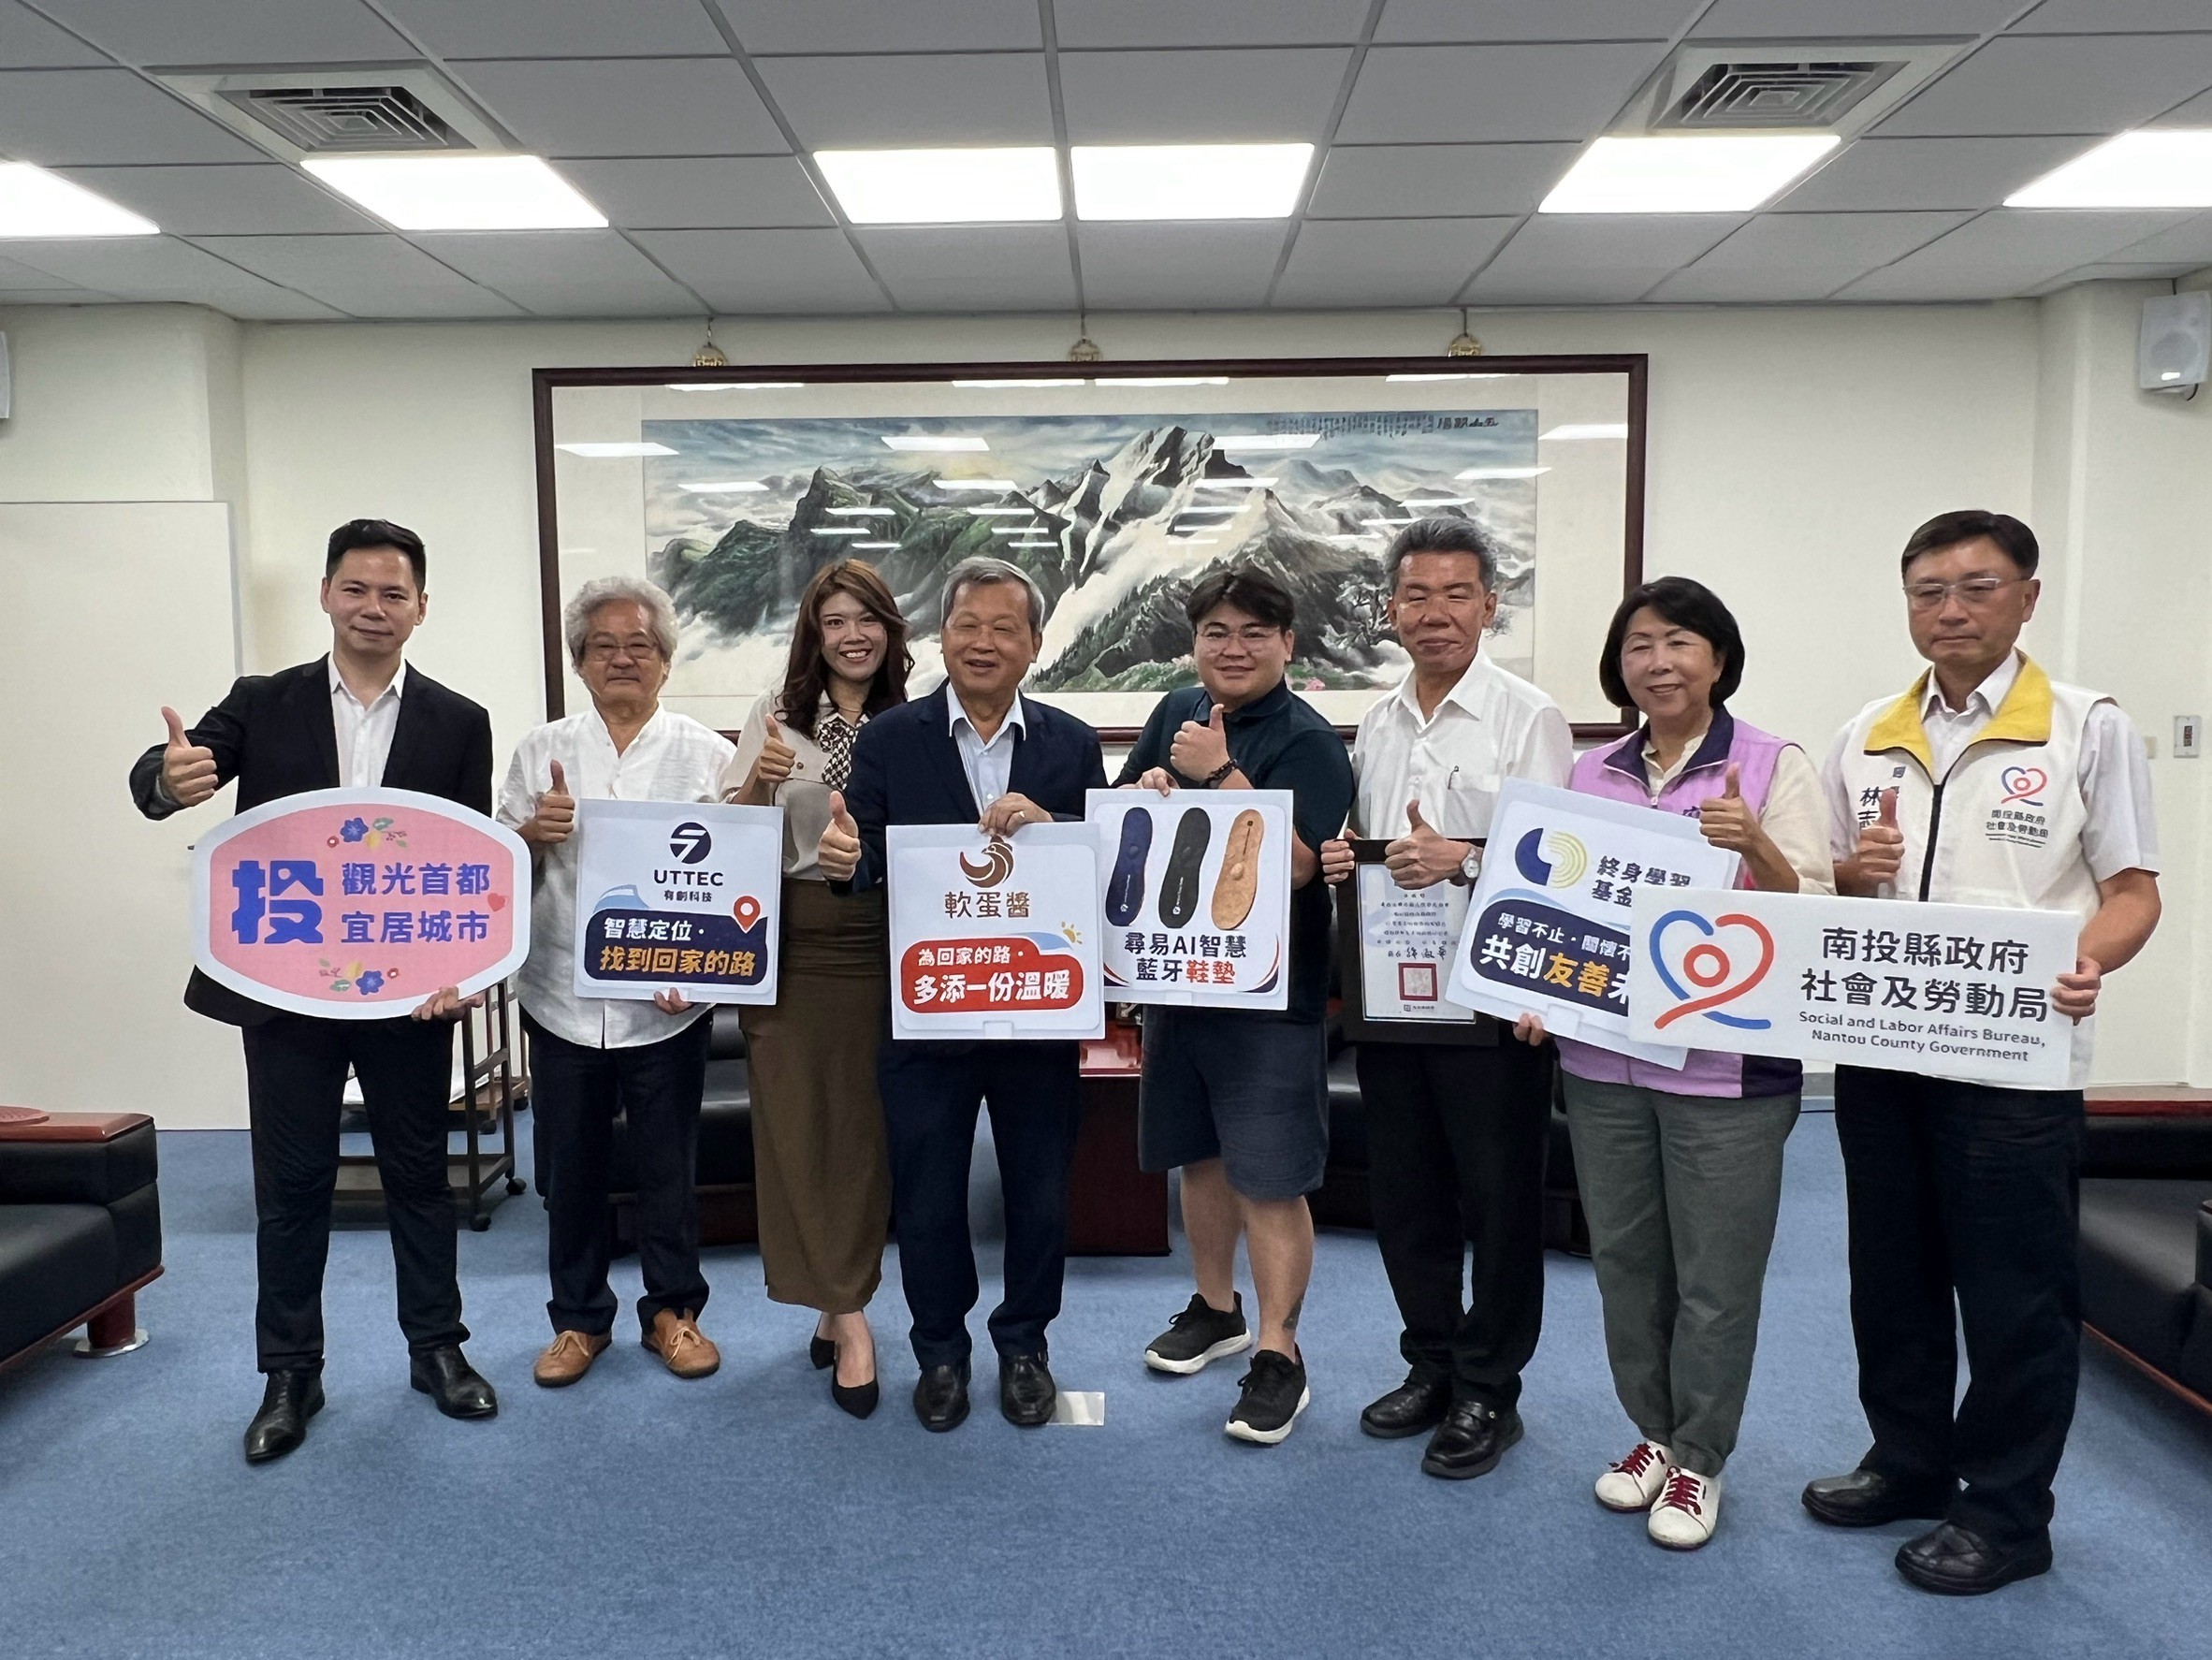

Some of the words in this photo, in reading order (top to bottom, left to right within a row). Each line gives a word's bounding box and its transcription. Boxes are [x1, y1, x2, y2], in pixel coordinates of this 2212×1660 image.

[342, 862, 490, 896] 觀光首都
[653, 869, 723, 886] UTTEC
[232, 860, 324, 944] 投
[663, 890, 713, 903] 有創科技
[944, 891, 1030, 919] 軟蛋醬
[341, 910, 489, 944] 宜居城市
[599, 946, 756, 977] 找到回家的路
[1125, 932, 1246, 958] 尋易AI智慧
[1822, 926, 2029, 974] 南投縣政府
[913, 969, 1070, 1005] 多添一份溫暖
[1136, 958, 1236, 984] 藍牙鞋墊
[1801, 968, 2048, 1023] 社會及勞動局
[1799, 1012, 1843, 1026] Social
[1847, 1017, 1875, 1028] and
[1880, 1020, 1924, 1033] Labor
[1928, 1024, 1978, 1039] Affairs
[1983, 1028, 2045, 1047] Bureau,
[1812, 1029, 1866, 1044] Nantou
[1870, 1035, 1925, 1053] County
[1929, 1041, 2029, 1061] Government
